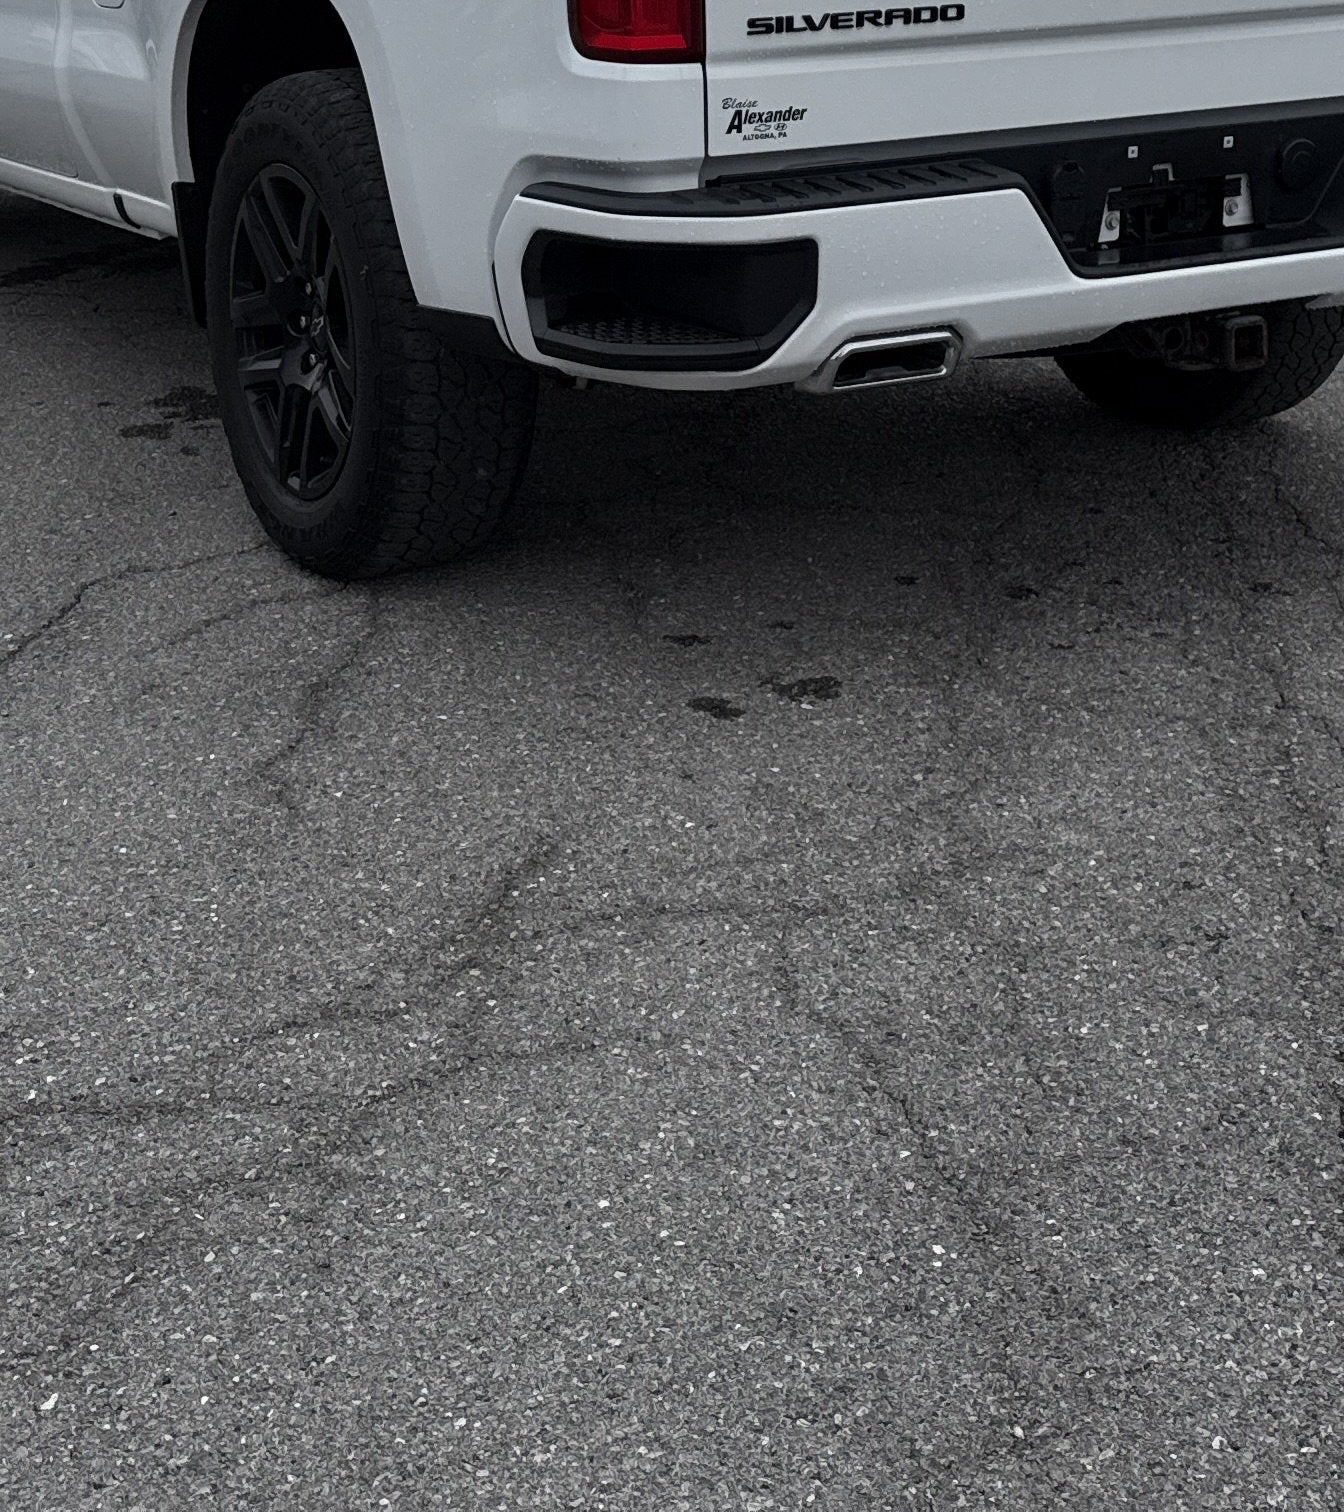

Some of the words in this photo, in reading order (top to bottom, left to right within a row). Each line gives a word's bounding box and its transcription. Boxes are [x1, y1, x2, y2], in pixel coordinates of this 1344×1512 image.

[746, 3, 965, 36] SILVERADO
[722, 97, 758, 110] Blaise
[725, 106, 808, 134] Alexander
